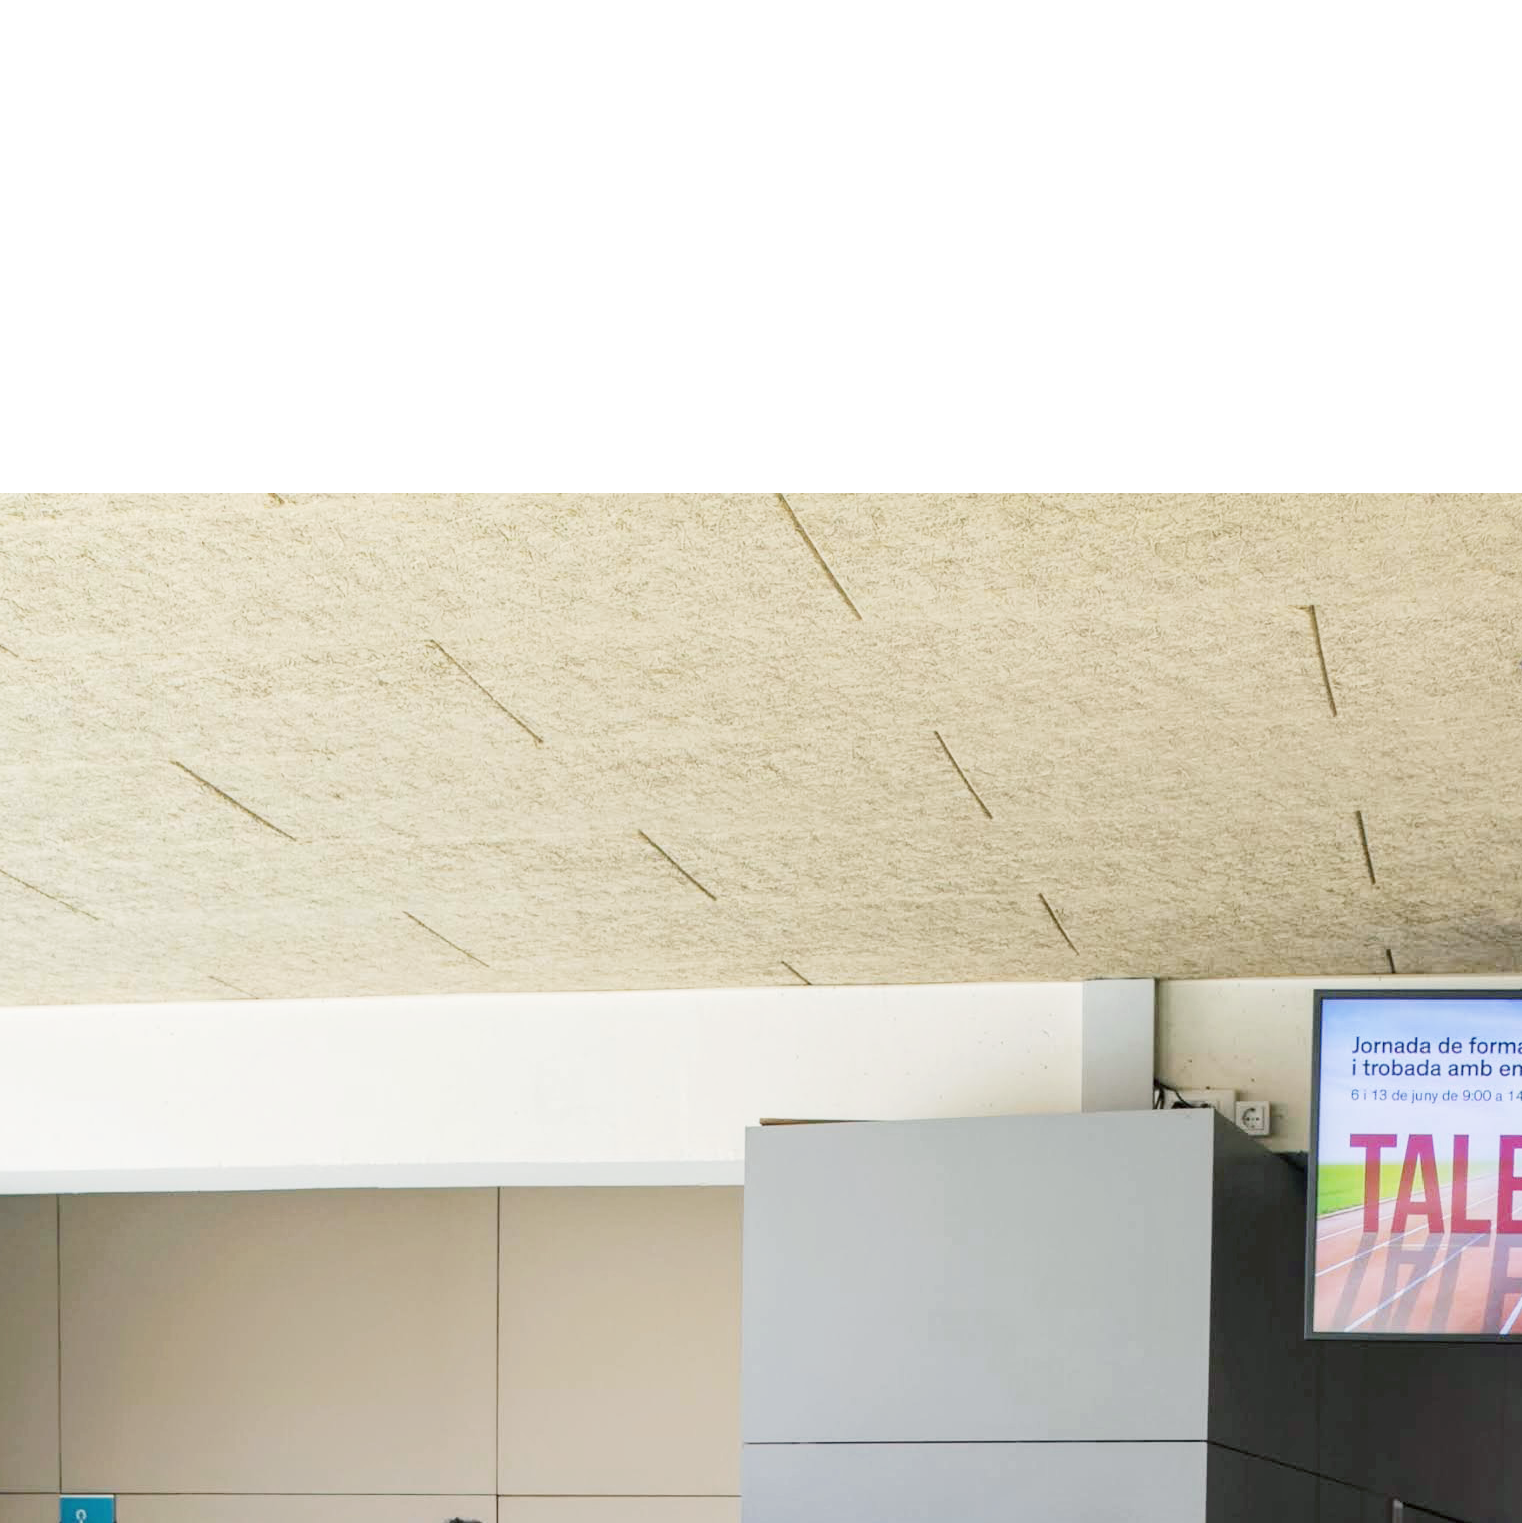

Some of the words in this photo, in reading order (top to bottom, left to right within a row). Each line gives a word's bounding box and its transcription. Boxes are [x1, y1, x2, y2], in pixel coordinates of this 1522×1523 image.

[1352, 1037, 1431, 1055] Jornada
[1438, 1037, 1463, 1054] de
[1352, 1059, 1356, 1076] i
[1363, 1059, 1441, 1077] trobada
[1448, 1059, 1492, 1077] amb
[1351, 1089, 1359, 1101] 6
[1372, 1089, 1387, 1101] 13
[1391, 1089, 1408, 1102] de
[1411, 1089, 1438, 1104] juny
[1442, 1089, 1458, 1102] de
[1462, 1089, 1492, 1102] 9:00
[1495, 1093, 1503, 1102] a
